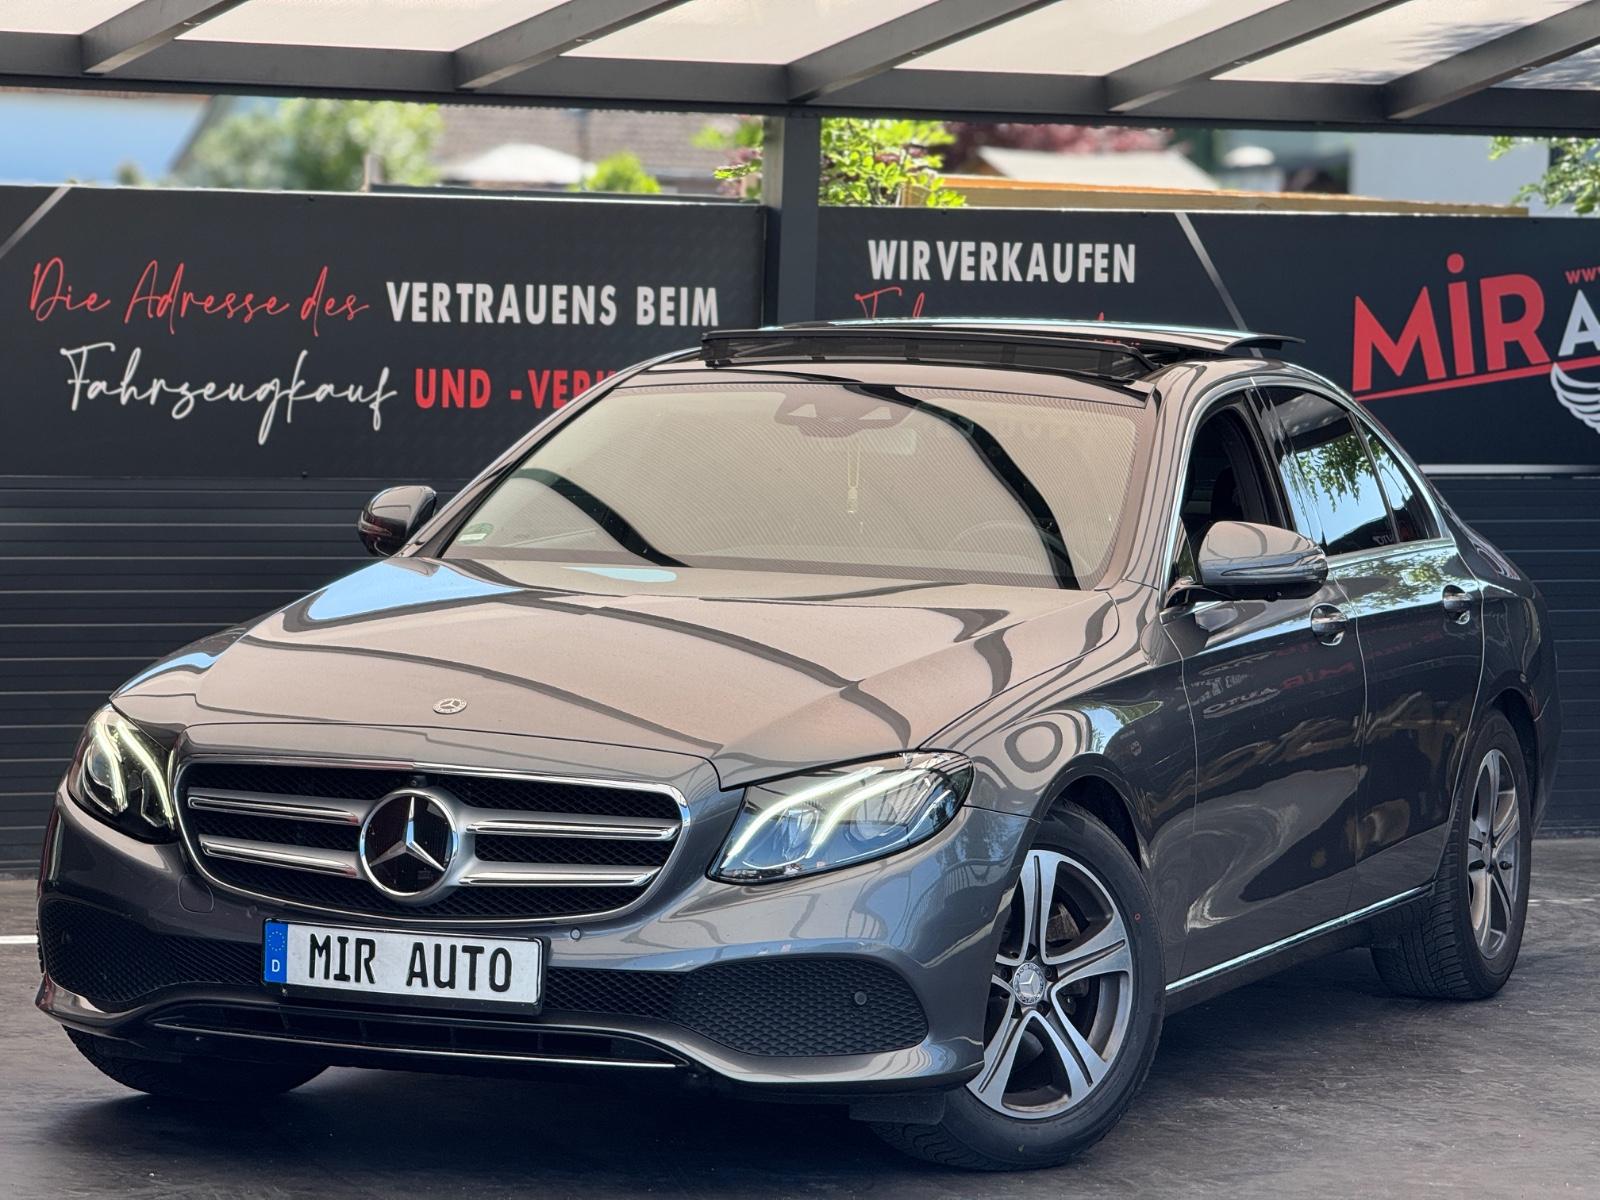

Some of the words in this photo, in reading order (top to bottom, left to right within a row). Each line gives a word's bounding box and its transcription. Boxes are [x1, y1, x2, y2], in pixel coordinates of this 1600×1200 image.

[29, 257, 111, 322] Die
[124, 259, 290, 335] Adresse
[300, 266, 370, 336] des
[386, 281, 618, 326] VERTRAUENS
[636, 286, 719, 327] BEIM
[60, 342, 398, 445] Fahrzeugkauf
[415, 368, 492, 409] UND
[271, 958, 281, 973] D
[308, 933, 376, 985] MIR
[406, 942, 513, 993] AUTO
